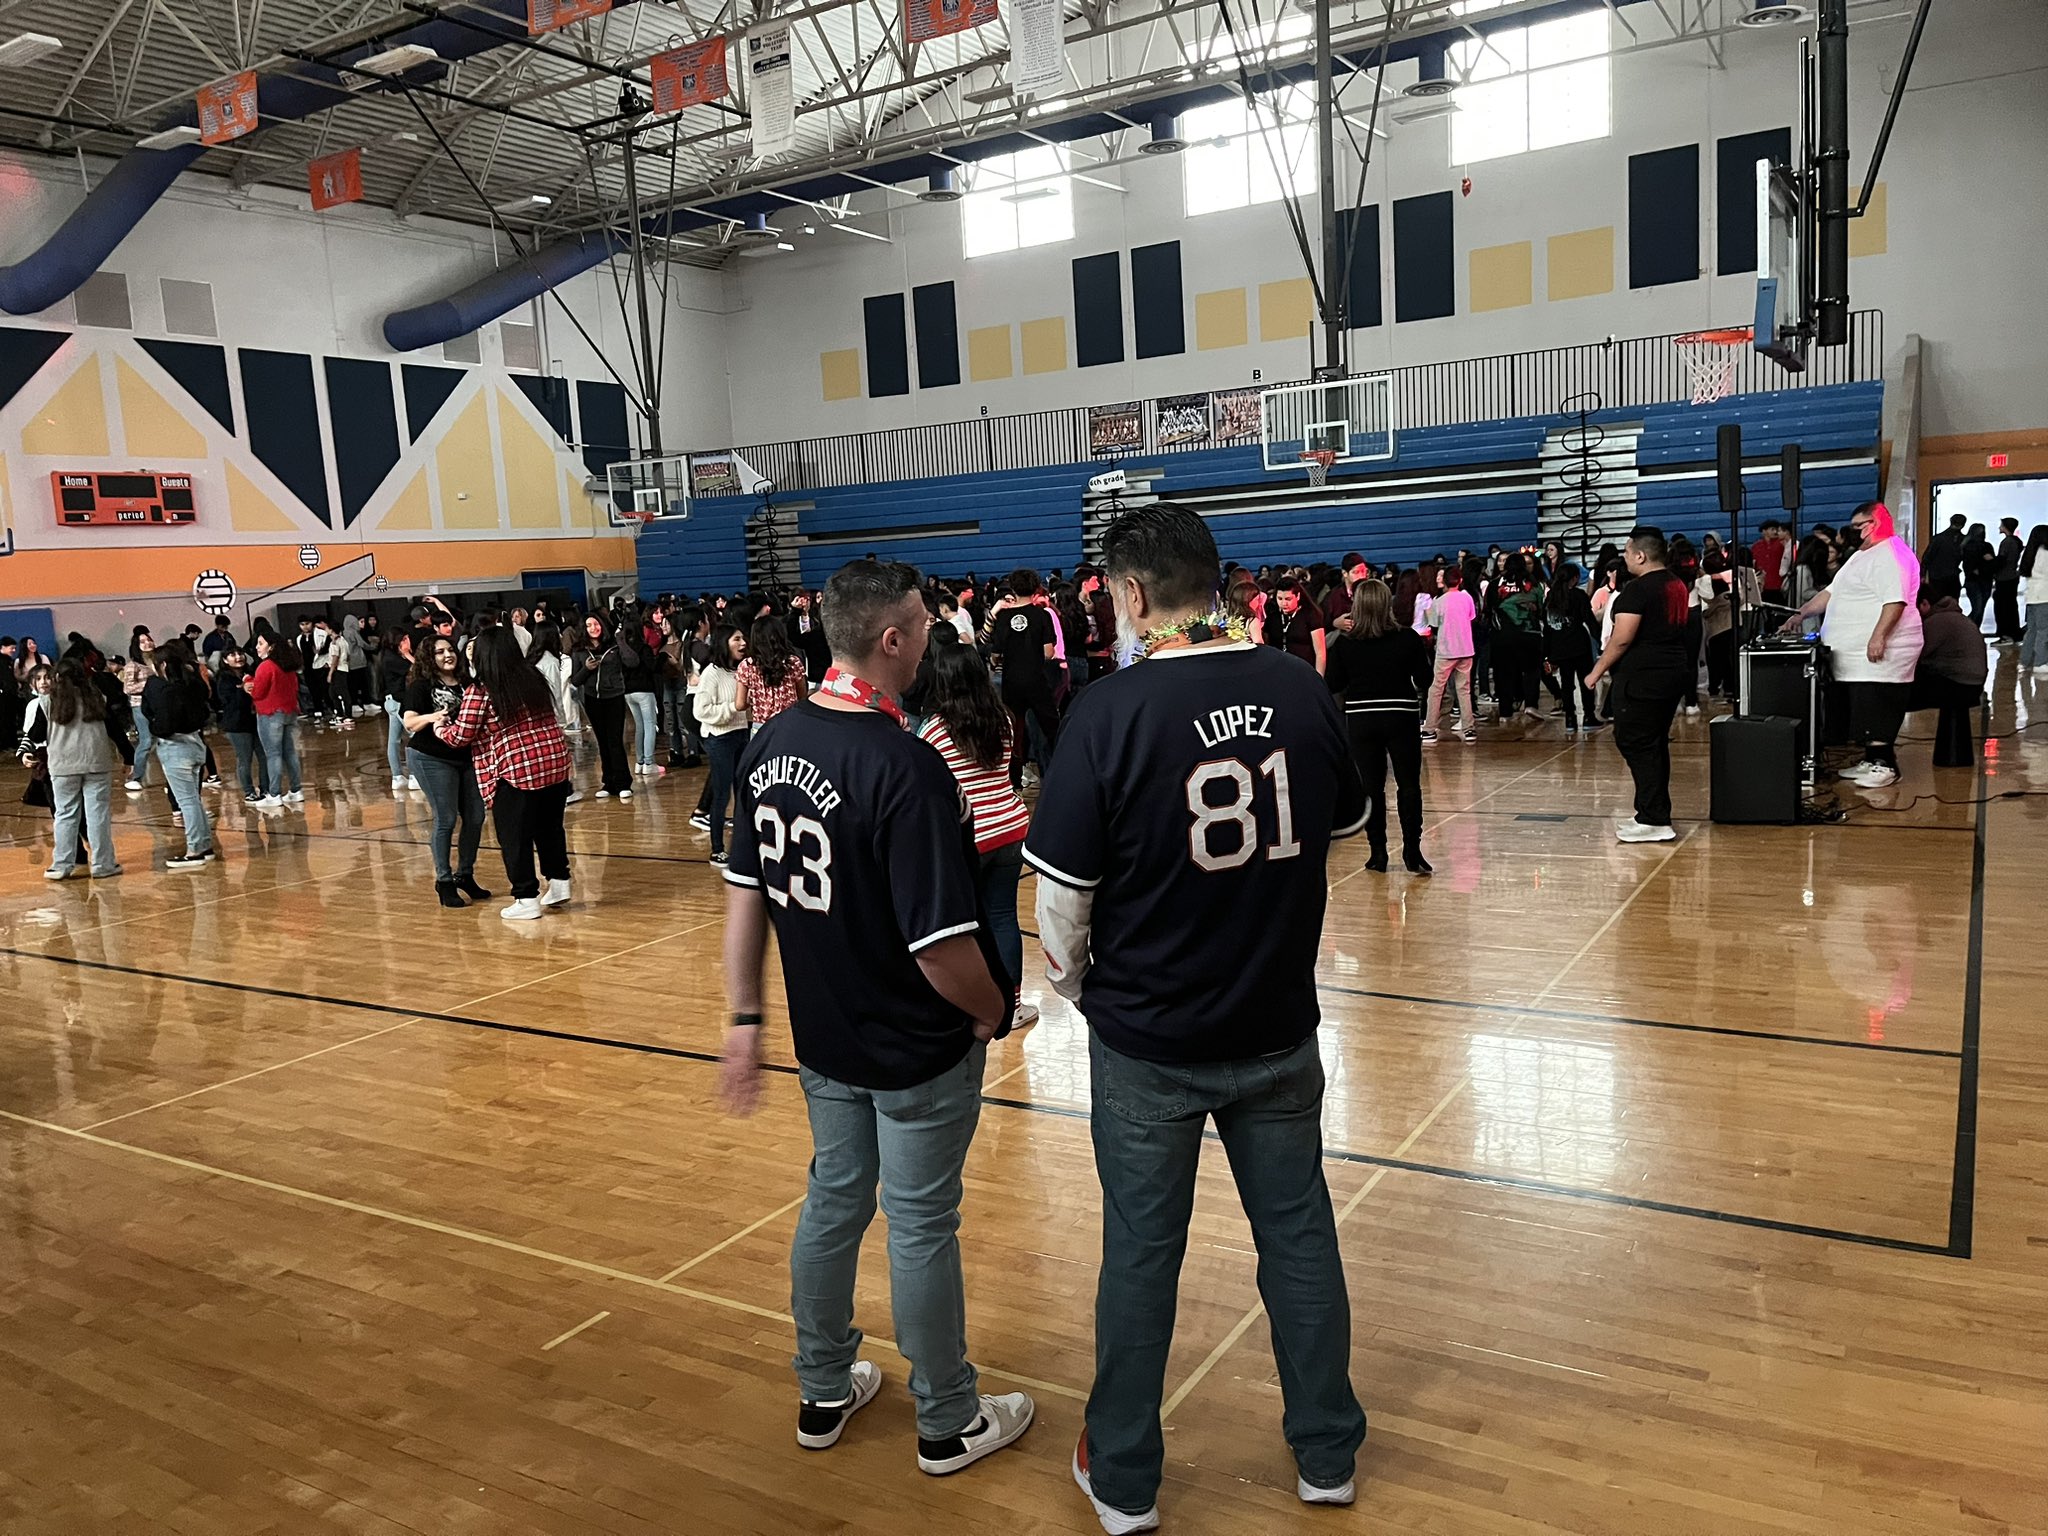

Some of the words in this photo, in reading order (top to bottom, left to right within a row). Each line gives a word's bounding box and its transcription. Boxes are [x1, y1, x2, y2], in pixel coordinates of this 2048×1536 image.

[1253, 369, 1262, 380] B
[980, 405, 988, 416] B
[65, 476, 88, 486] Home
[1103, 475, 1124, 485] grade
[118, 511, 145, 521] period
[1193, 705, 1274, 748] LOPEZ
[748, 755, 842, 818] SCHUETZLER
[1185, 748, 1302, 872] 81
[754, 803, 832, 914] 23
